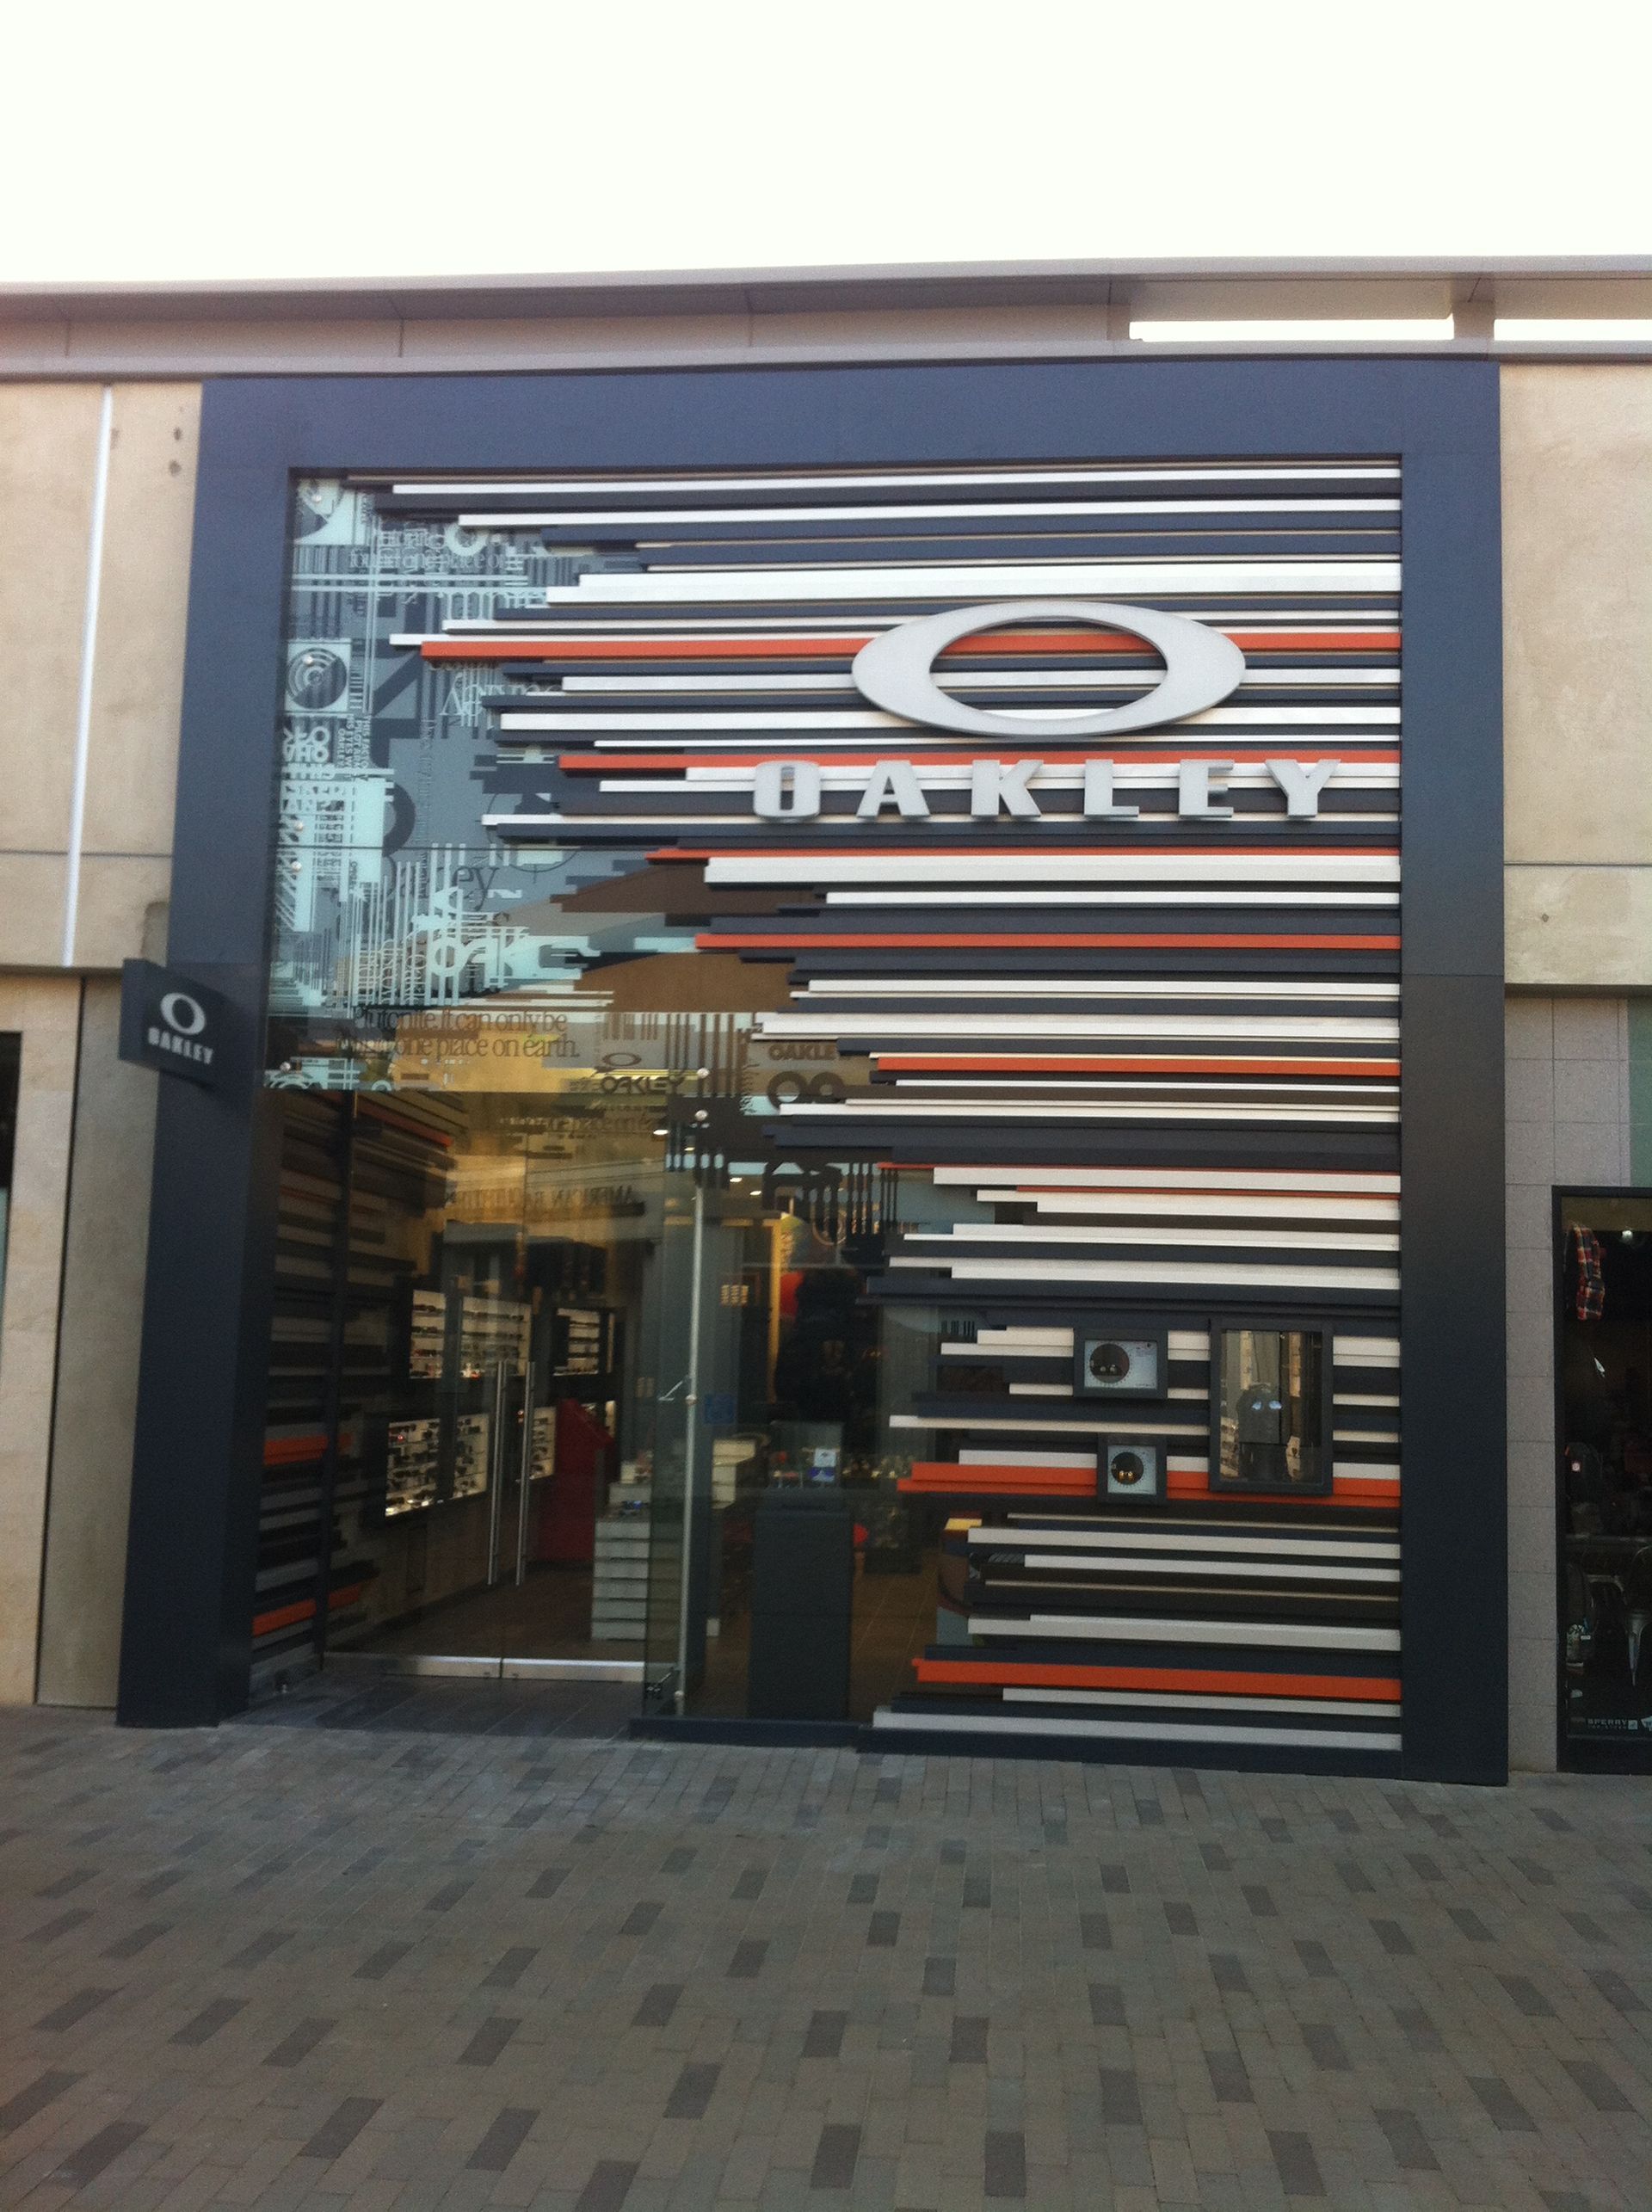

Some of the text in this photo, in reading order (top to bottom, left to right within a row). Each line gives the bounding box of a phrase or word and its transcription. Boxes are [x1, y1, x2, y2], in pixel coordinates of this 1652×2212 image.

[753, 758, 1342, 822] OAKLEY
[454, 1014, 491, 1032] can
[495, 1009, 543, 1038] only
[544, 1009, 568, 1032] be
[397, 1038, 434, 1057] one
[436, 1034, 488, 1060] place
[492, 1038, 520, 1057] on
[600, 1075, 687, 1095] OAKLEY
